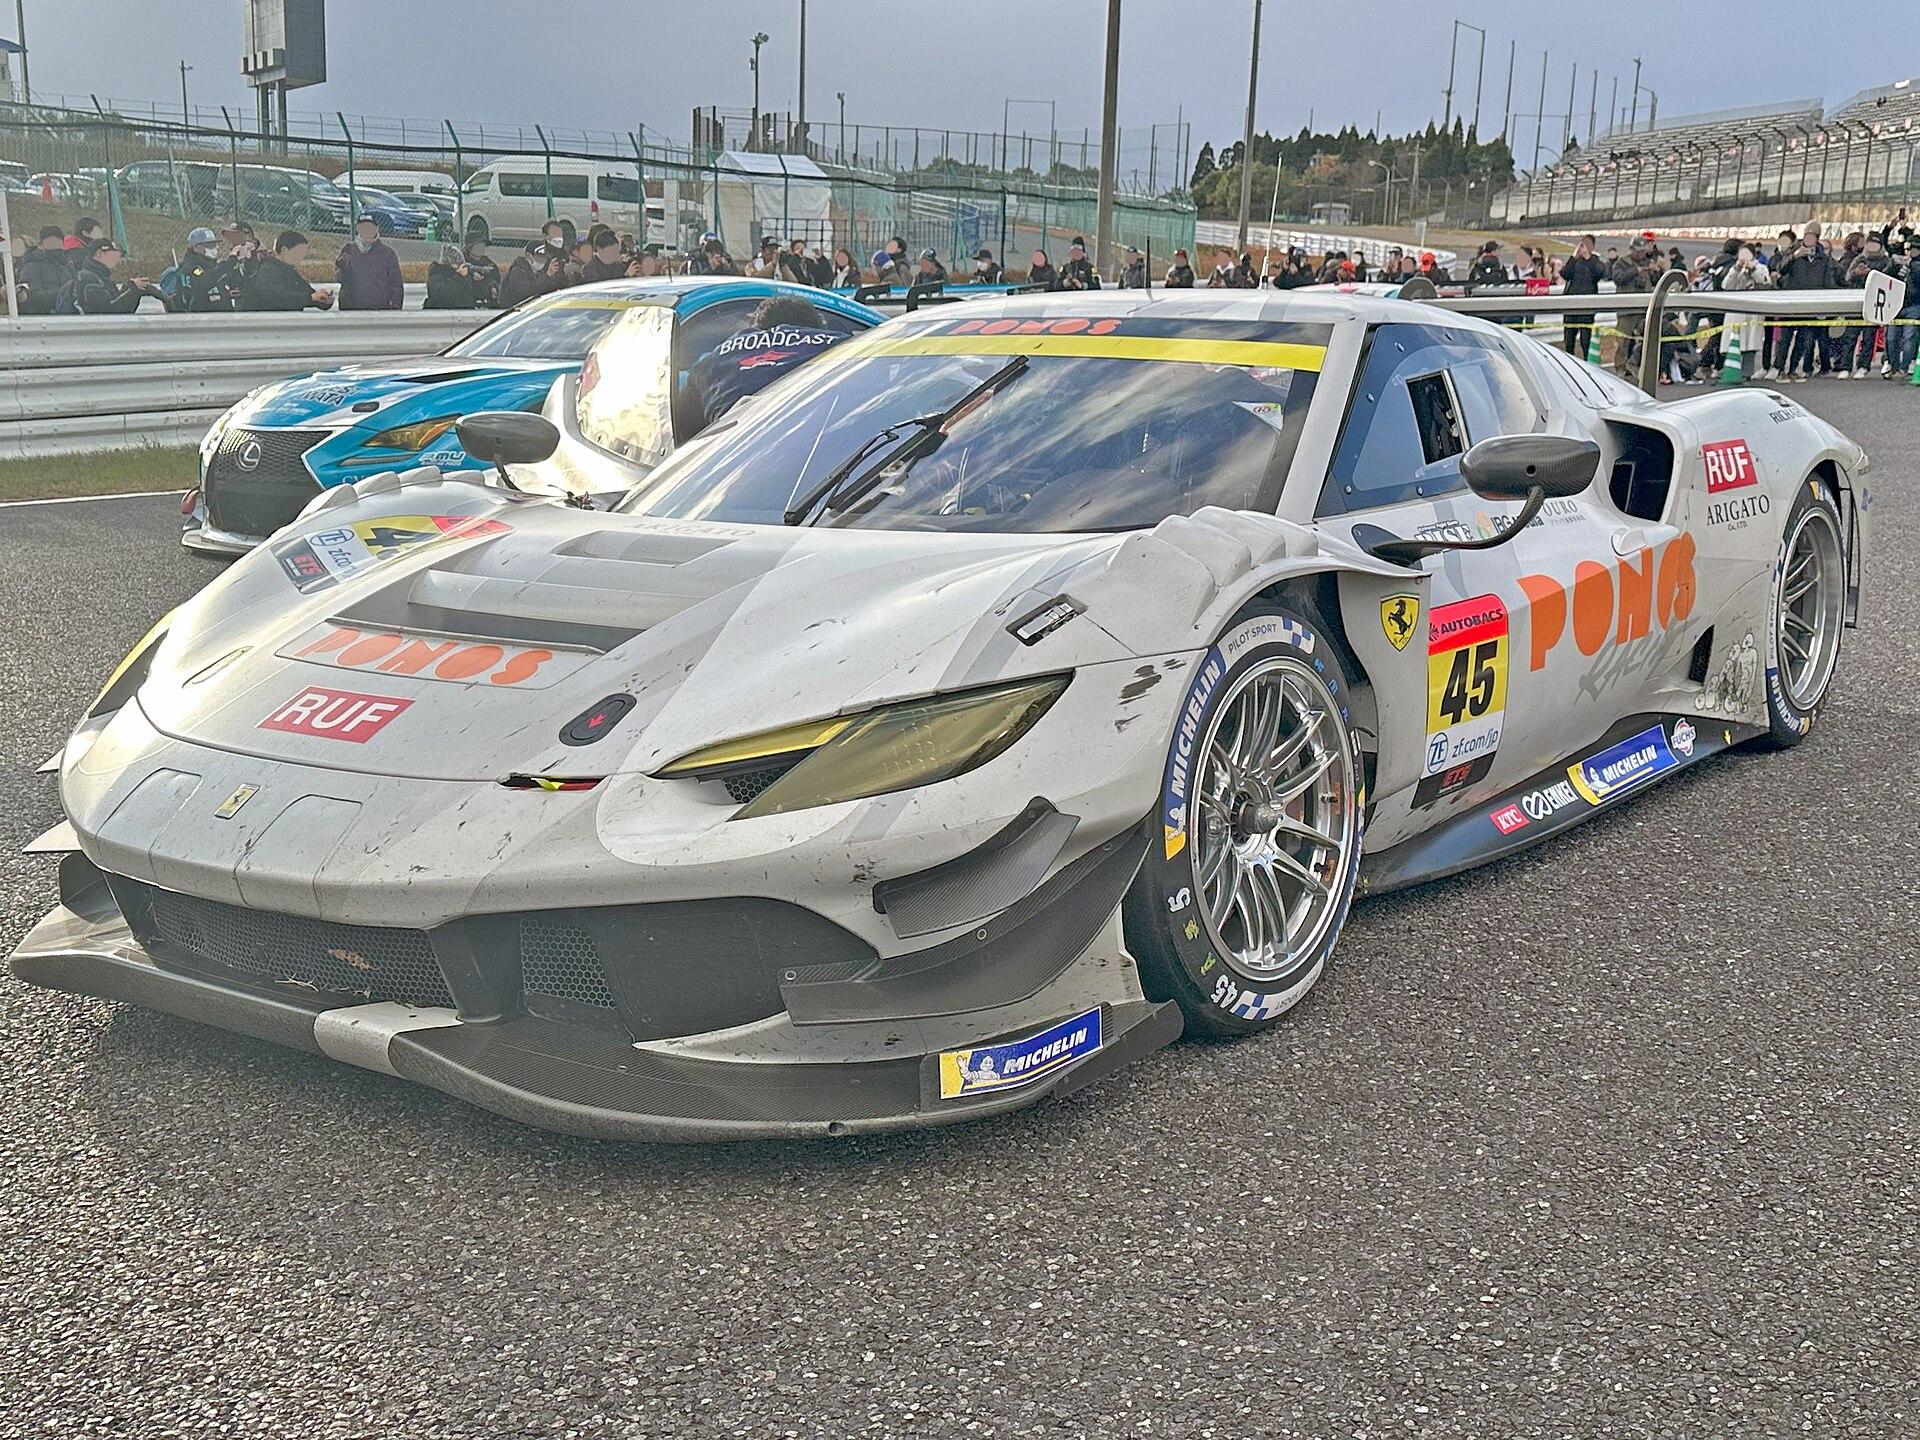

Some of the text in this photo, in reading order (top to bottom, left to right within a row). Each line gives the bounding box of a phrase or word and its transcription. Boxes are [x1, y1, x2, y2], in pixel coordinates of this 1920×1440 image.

[947, 319, 1122, 335] PONOS
[719, 331, 836, 356] BROADCAST
[1705, 446, 1749, 486] RUF
[1543, 500, 1578, 517] OURO
[1706, 494, 1770, 527] ARIGATO
[1517, 531, 1696, 672] PONOS
[1440, 608, 1504, 634] AUTOBACS
[1229, 623, 1277, 654] PILOT SPORT
[294, 626, 553, 685] PONOS
[1439, 640, 1498, 725] 45
[273, 693, 400, 733] RUF
[1771, 674, 1801, 731] MICHELIN
[1170, 659, 1222, 798] MICHELIN
[1451, 728, 1499, 758] zf.com/jp
[1672, 727, 1696, 748] FUCHS
[1429, 740, 1447, 768] ZF
[1602, 744, 1658, 783] MICHELIN
[1542, 780, 1579, 810] ENKEI
[1497, 809, 1523, 830] KTC
[1167, 887, 1191, 913] 5
[1210, 974, 1239, 1009] 45
[1003, 1028, 1088, 1075] MICHELIN
